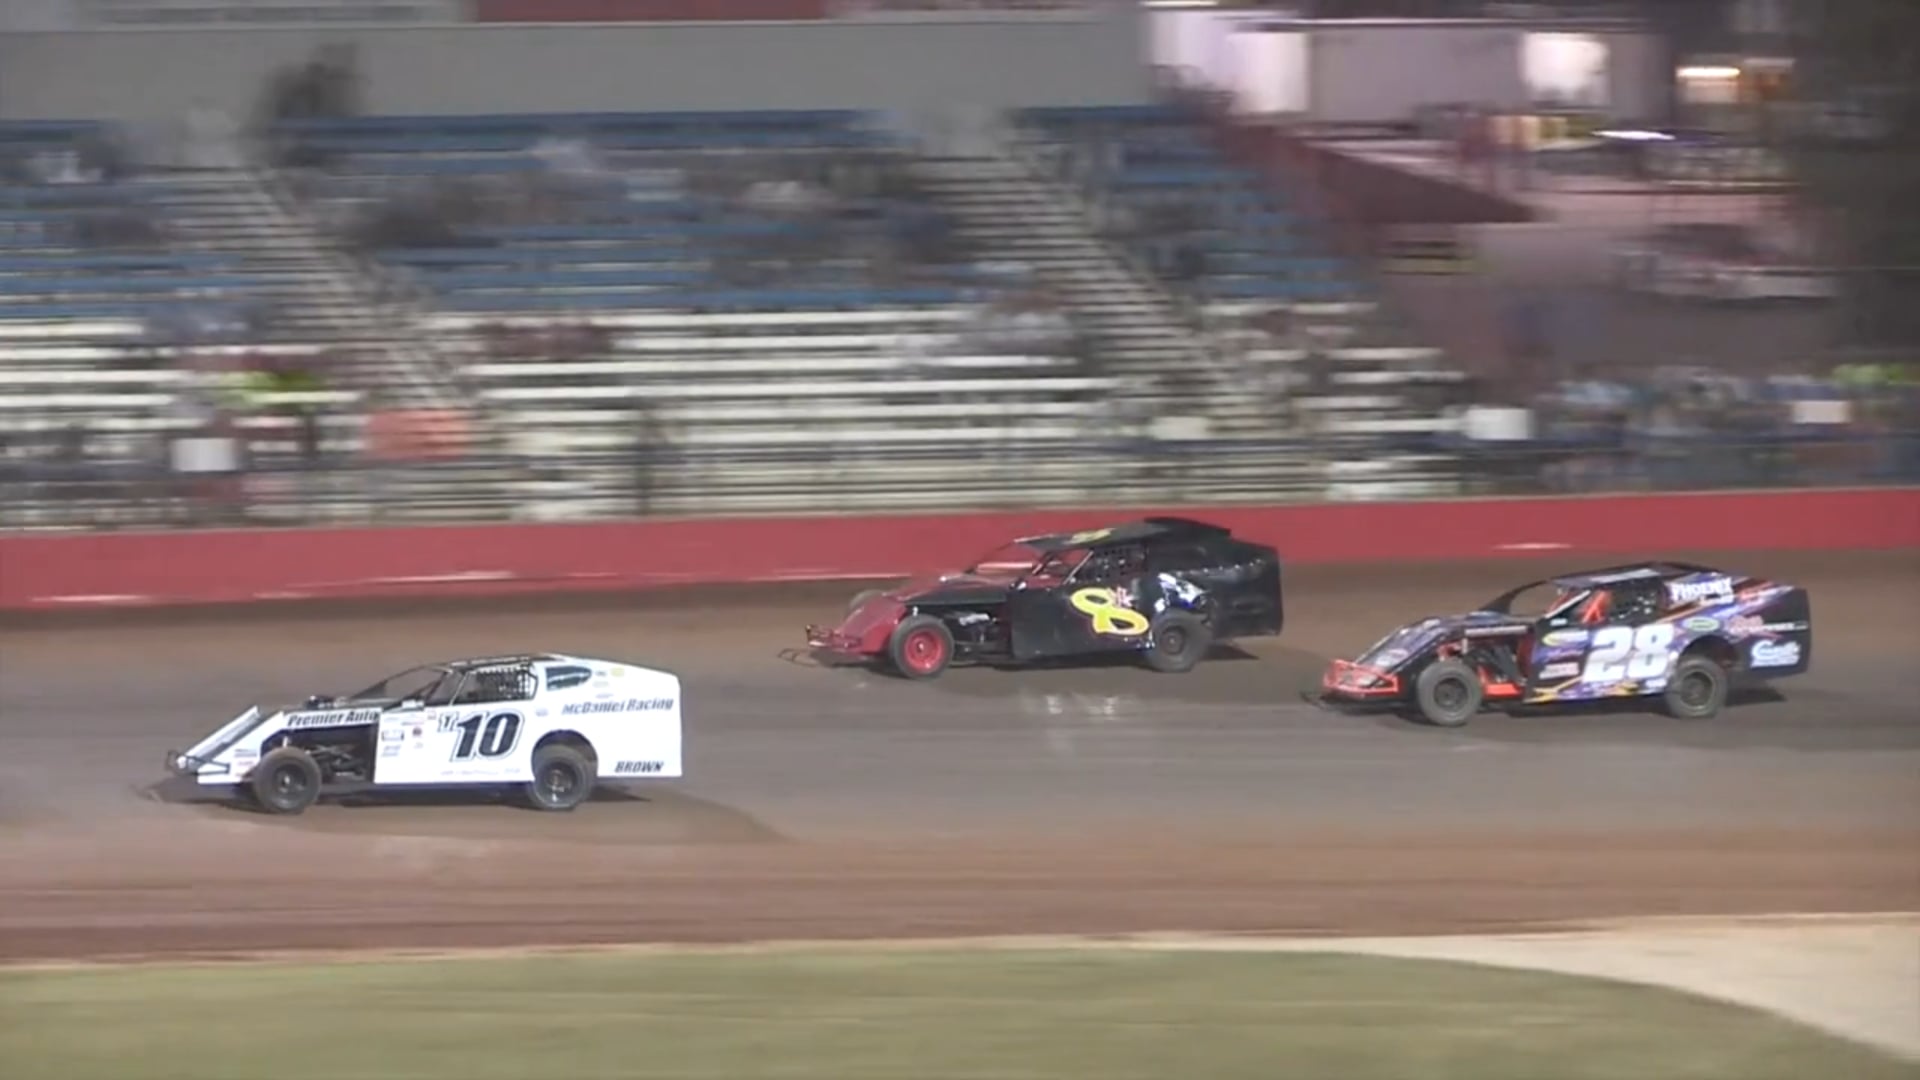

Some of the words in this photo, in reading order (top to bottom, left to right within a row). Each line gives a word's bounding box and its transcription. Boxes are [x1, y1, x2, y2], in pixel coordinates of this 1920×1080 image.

[1582, 622, 1675, 683] 28
[626, 698, 674, 711] Racing
[287, 712, 344, 727] Premier
[454, 711, 522, 760] 10
[614, 760, 664, 773] BROWN
